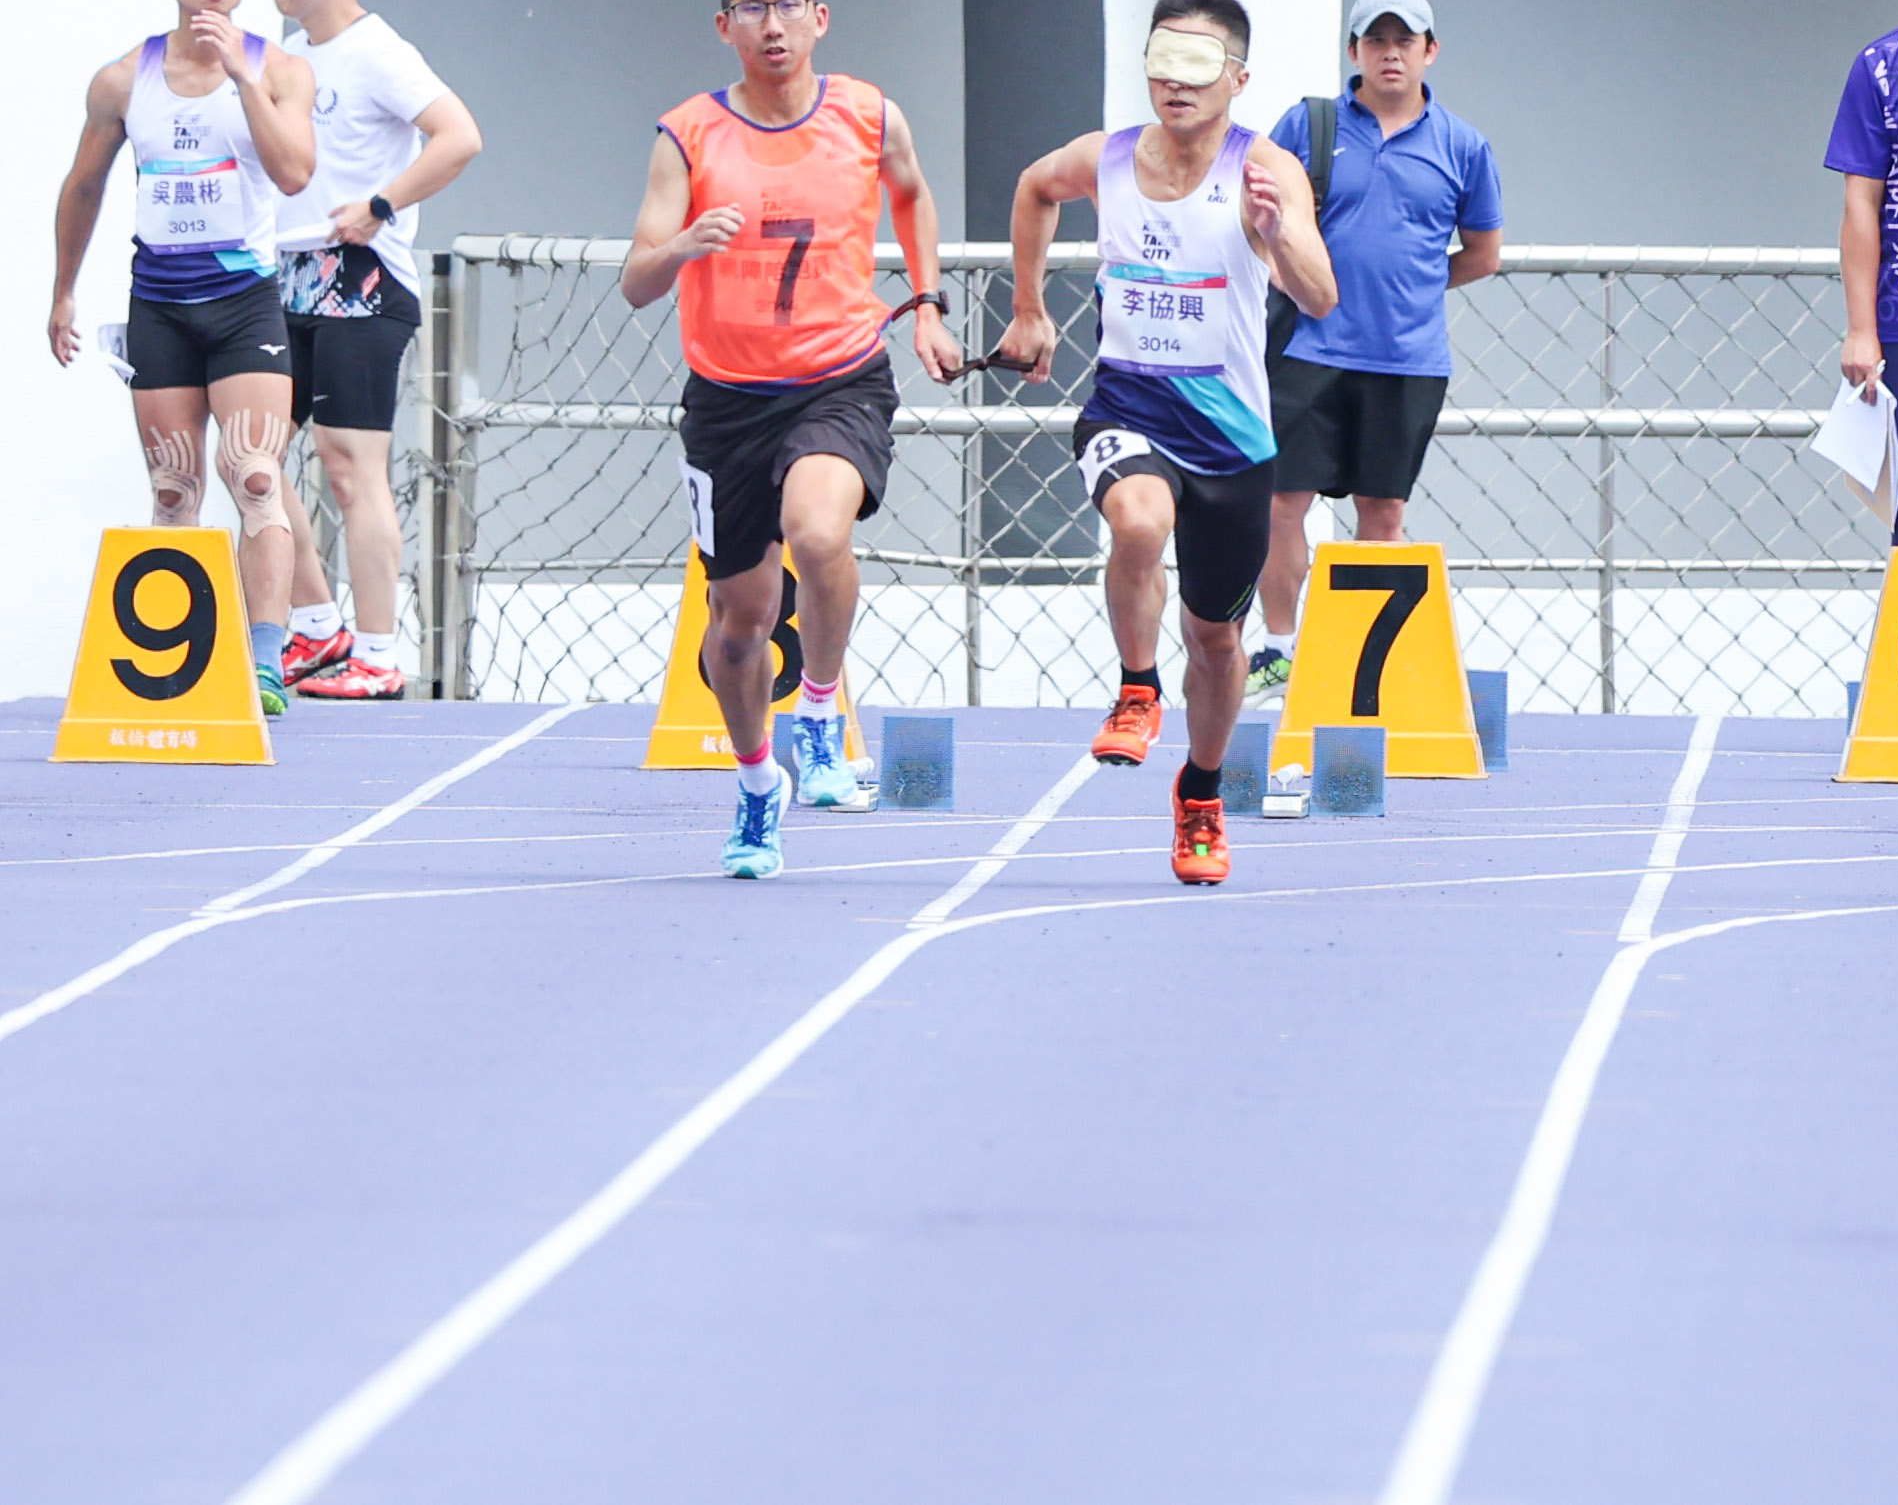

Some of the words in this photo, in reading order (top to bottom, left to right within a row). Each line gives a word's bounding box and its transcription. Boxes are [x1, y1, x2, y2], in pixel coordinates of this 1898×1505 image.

[152, 178, 222, 205] 吳農彬
[168, 220, 206, 233] 3013
[761, 219, 814, 325] 7
[1122, 288, 1204, 322] 李協興
[1138, 336, 1181, 352] 3014
[1094, 436, 1122, 463] 8
[110, 548, 217, 701] 9
[1329, 564, 1428, 717] 7
